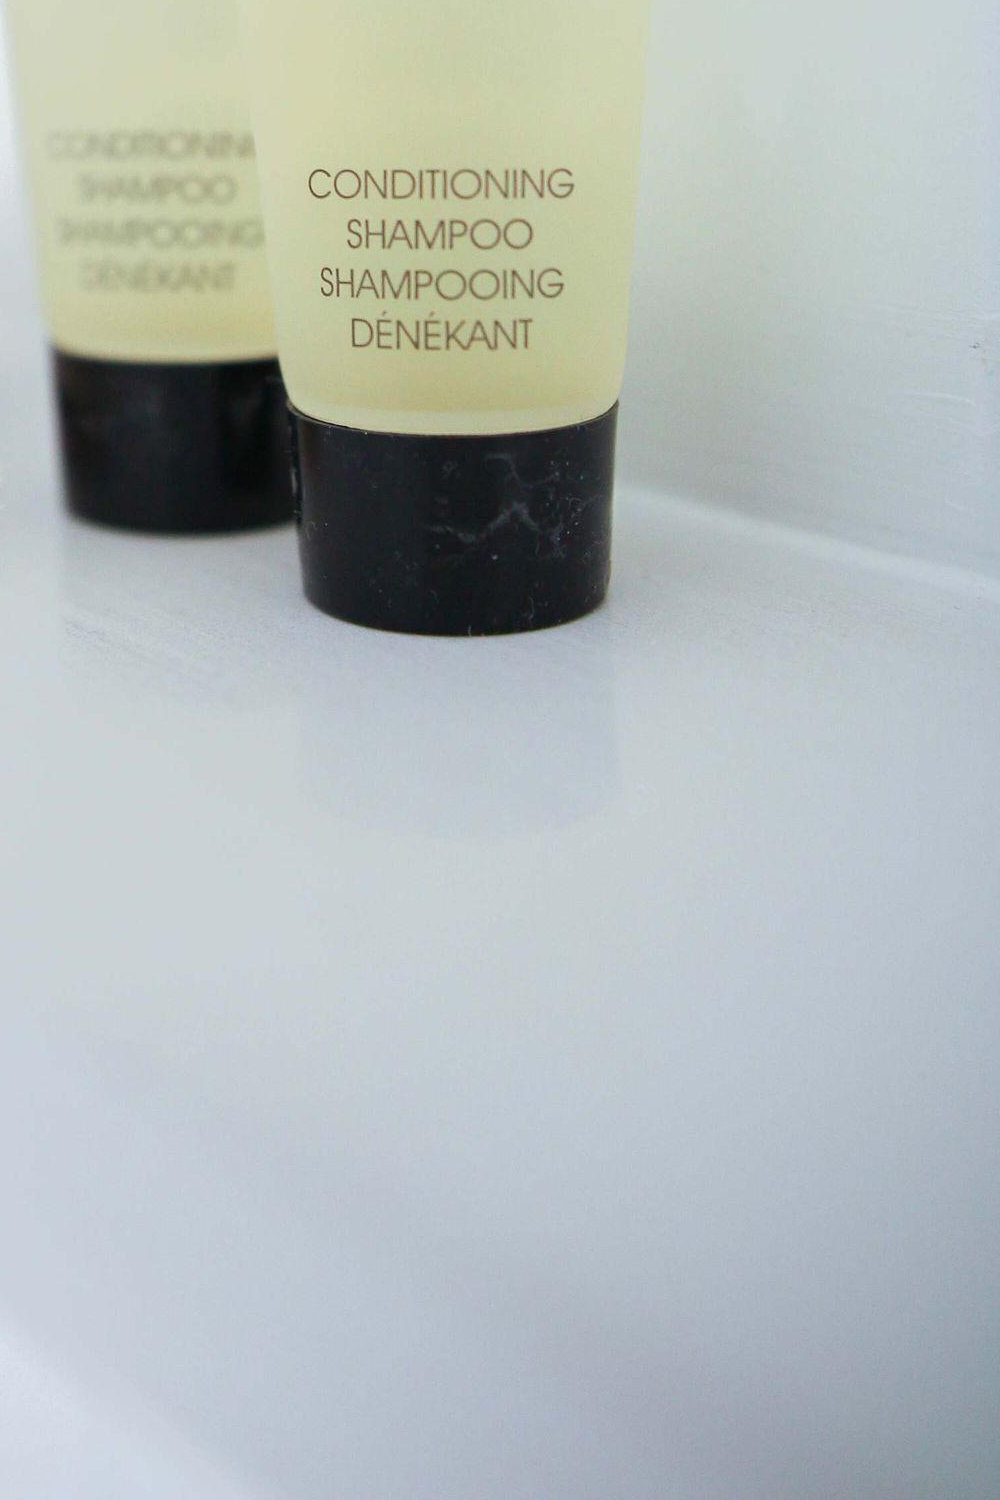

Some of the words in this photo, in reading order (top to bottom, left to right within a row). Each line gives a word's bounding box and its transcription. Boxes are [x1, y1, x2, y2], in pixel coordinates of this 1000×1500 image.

[308, 168, 575, 200] CONDITIONING
[347, 218, 533, 250] SHAMPOO
[320, 267, 564, 300] SHAMPOOING
[351, 311, 533, 350] DÉNÉKANT
